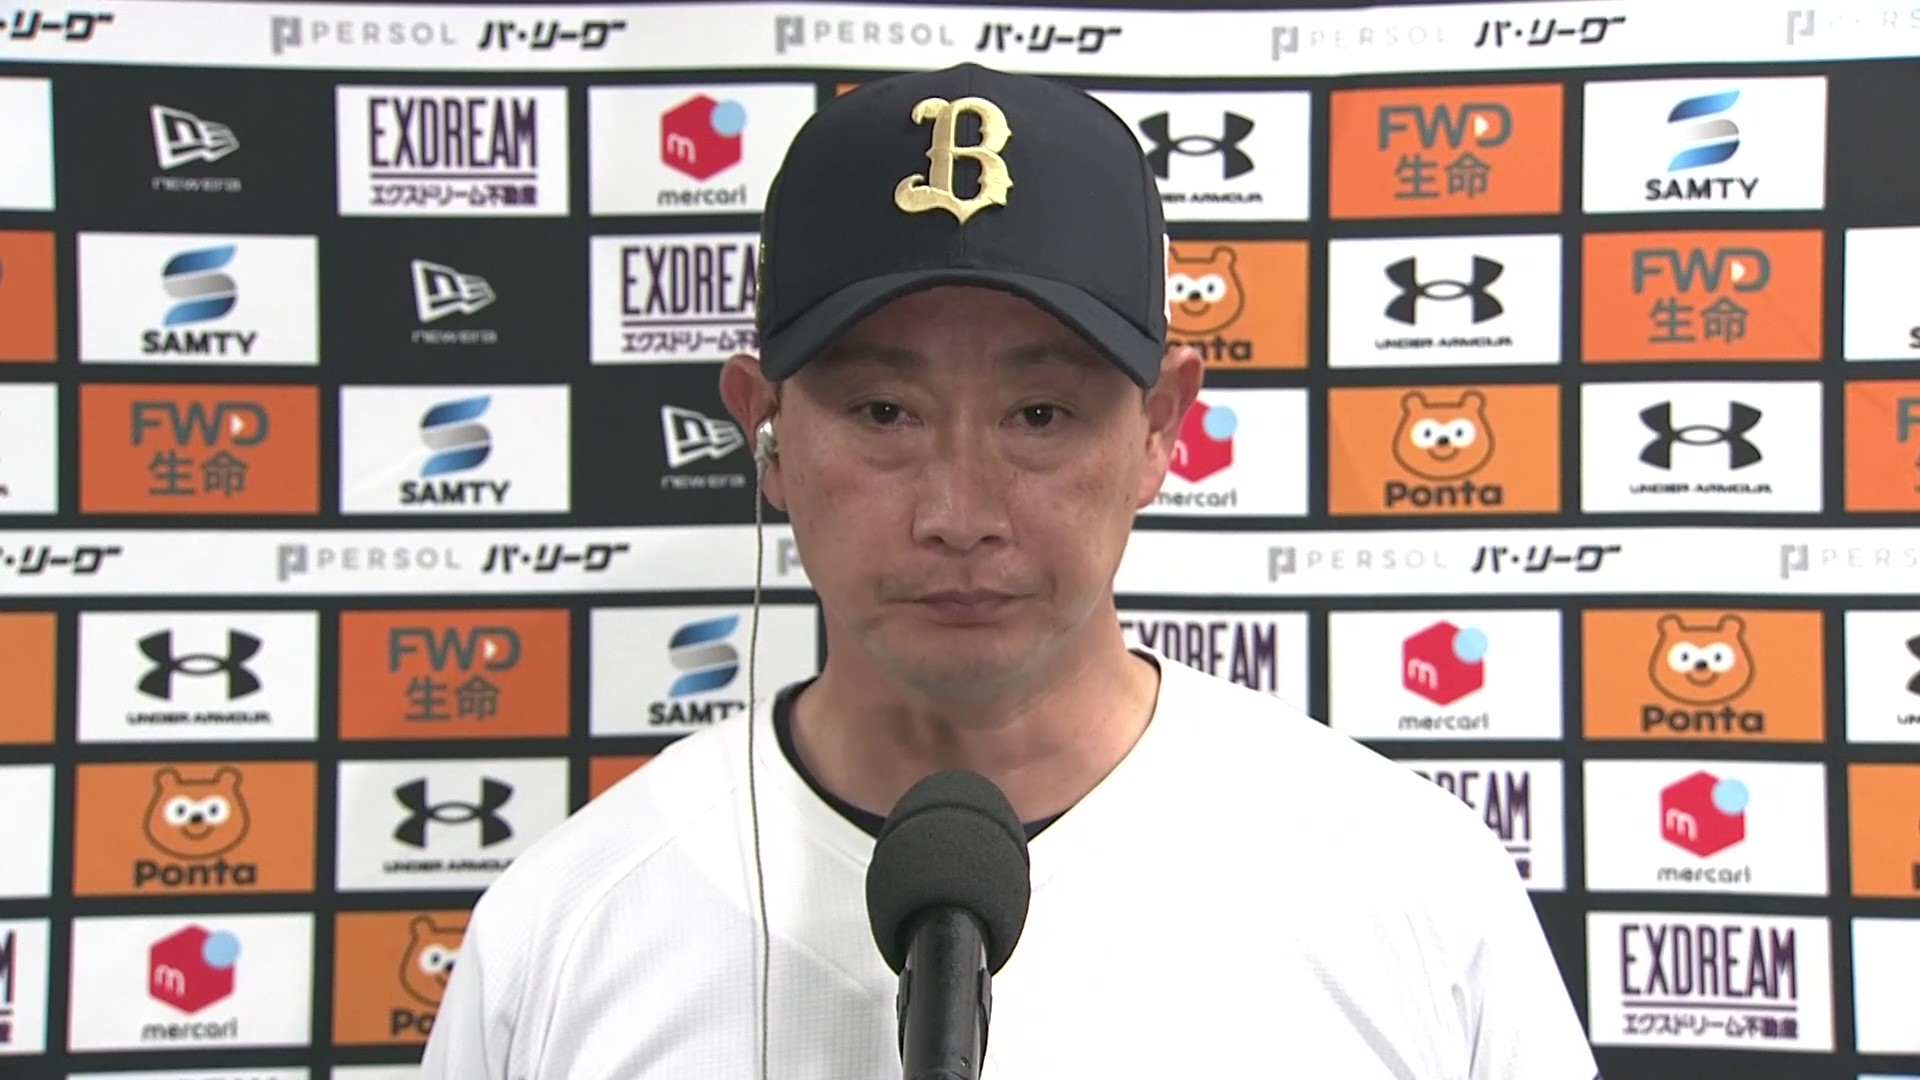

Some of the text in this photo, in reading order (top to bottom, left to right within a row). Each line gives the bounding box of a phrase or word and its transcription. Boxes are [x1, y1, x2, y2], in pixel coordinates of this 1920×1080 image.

[311, 20, 456, 46] PERSOL
[814, 19, 954, 46] PERSOL
[1311, 26, 1448, 49] PERSOL
[368, 95, 538, 169] EXDREAM
[1377, 101, 1514, 151] FWD
[893, 96, 1014, 224] B
[1394, 152, 1492, 200] 生命
[1644, 177, 1760, 202] SAMTY
[657, 184, 747, 206] mercari
[1631, 246, 1772, 294] FWD
[1647, 297, 1749, 345] 生命
[141, 330, 258, 356] SAMTY
[130, 399, 271, 447] FWD
[148, 450, 249, 498] 生命
[399, 480, 510, 505] SAMTY
[1385, 478, 1504, 508] Ponta
[0, 545, 123, 576] ・リーグ
[317, 547, 461, 571] PERSOL
[1307, 548, 1447, 570] PERSOL
[388, 626, 522, 673] FWD
[403, 675, 501, 723] 生命
[1398, 709, 1489, 732] mercari
[1639, 703, 1764, 735] Ponta
[133, 858, 257, 888] Ponta
[1657, 864, 1751, 884] mercari
[1619, 923, 1798, 1000] EXDREAM
[141, 1017, 238, 1042] mercari
